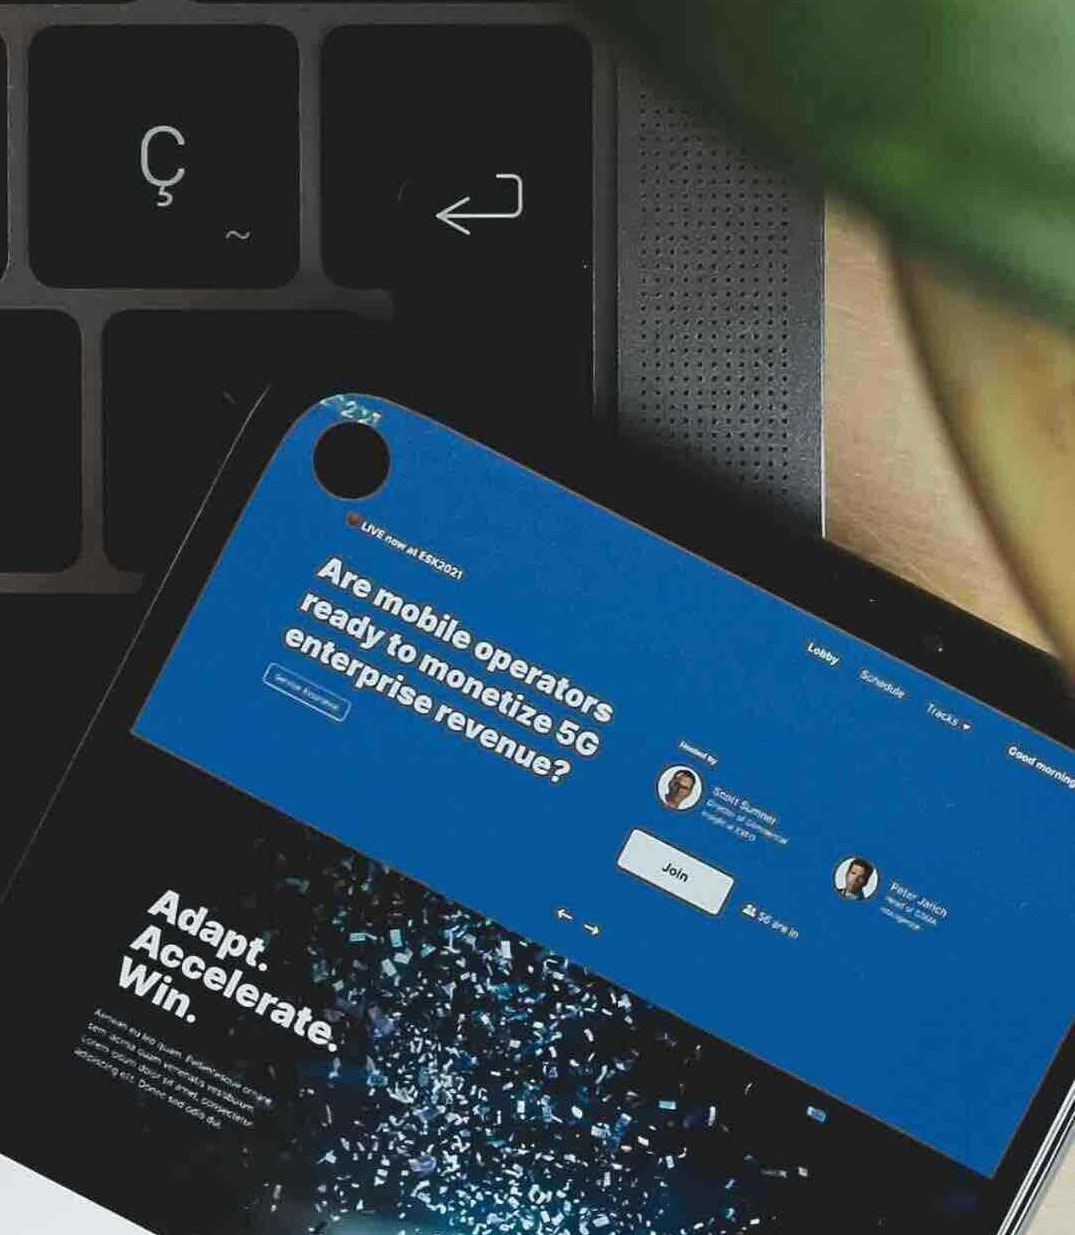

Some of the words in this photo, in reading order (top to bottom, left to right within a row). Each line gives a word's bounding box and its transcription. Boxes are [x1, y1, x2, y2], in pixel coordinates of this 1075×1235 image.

[140, 126, 186, 206] Ç
[361, 521, 386, 541] LIVE
[384, 534, 407, 551] now
[406, 546, 419, 558] at
[317, 556, 372, 599] Are
[373, 587, 471, 651] mobile
[473, 641, 614, 724] operators
[807, 641, 840, 667] Lobby
[300, 591, 386, 650] ready
[386, 632, 417, 665] to
[418, 652, 553, 735] monetize
[555, 719, 600, 757] 5G
[859, 668, 906, 700] Schedule
[285, 626, 433, 715] enterprise
[434, 703, 571, 783] revenue?
[926, 701, 960, 728] Tracks
[1006, 744, 1037, 767] Good
[1035, 760, 1075, 789] morning
[712, 786, 741, 806] Scott
[661, 861, 689, 884] Join
[889, 881, 918, 901] Peter
[147, 889, 268, 972] Adapt.
[118, 955, 196, 1024] Win.
[129, 924, 338, 1053] Accelerate.
